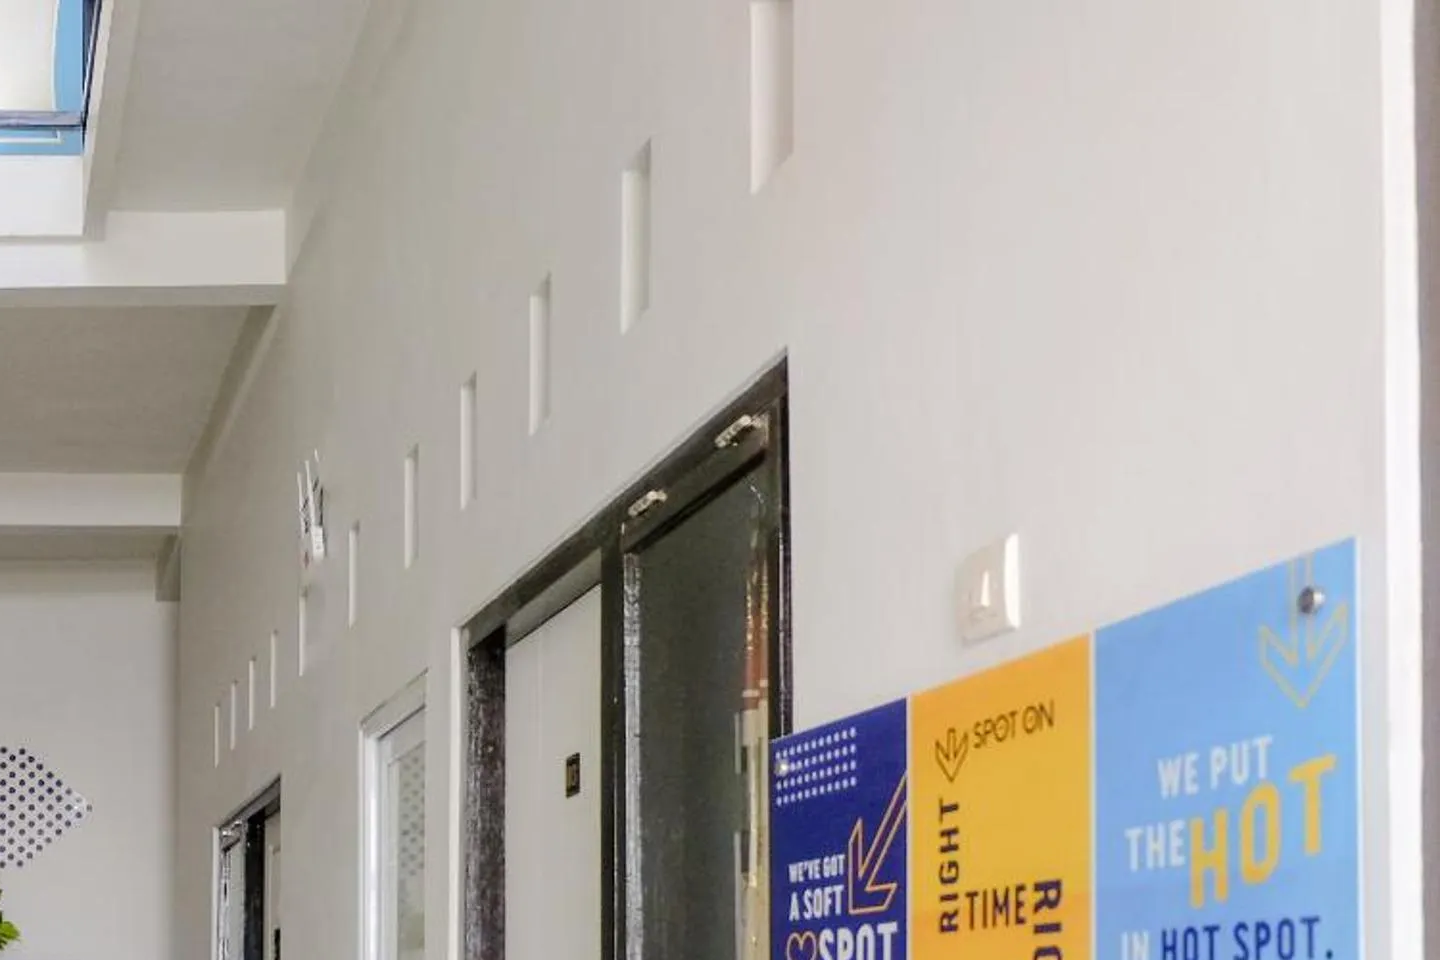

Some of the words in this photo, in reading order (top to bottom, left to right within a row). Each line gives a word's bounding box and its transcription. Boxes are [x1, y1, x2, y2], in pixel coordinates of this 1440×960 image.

[972, 711, 1017, 750] SPOT
[1022, 699, 1055, 735] ON
[1157, 752, 1200, 800] WE
[1210, 734, 1273, 790] PUT
[1124, 819, 1186, 872] THE
[1188, 752, 1338, 909] HOT
[788, 859, 822, 884] WE'VE
[823, 854, 845, 878] GOT
[938, 797, 960, 933] RIGHT
[788, 891, 800, 922] A
[803, 884, 845, 919] SOFT
[965, 884, 1027, 931] TIME
